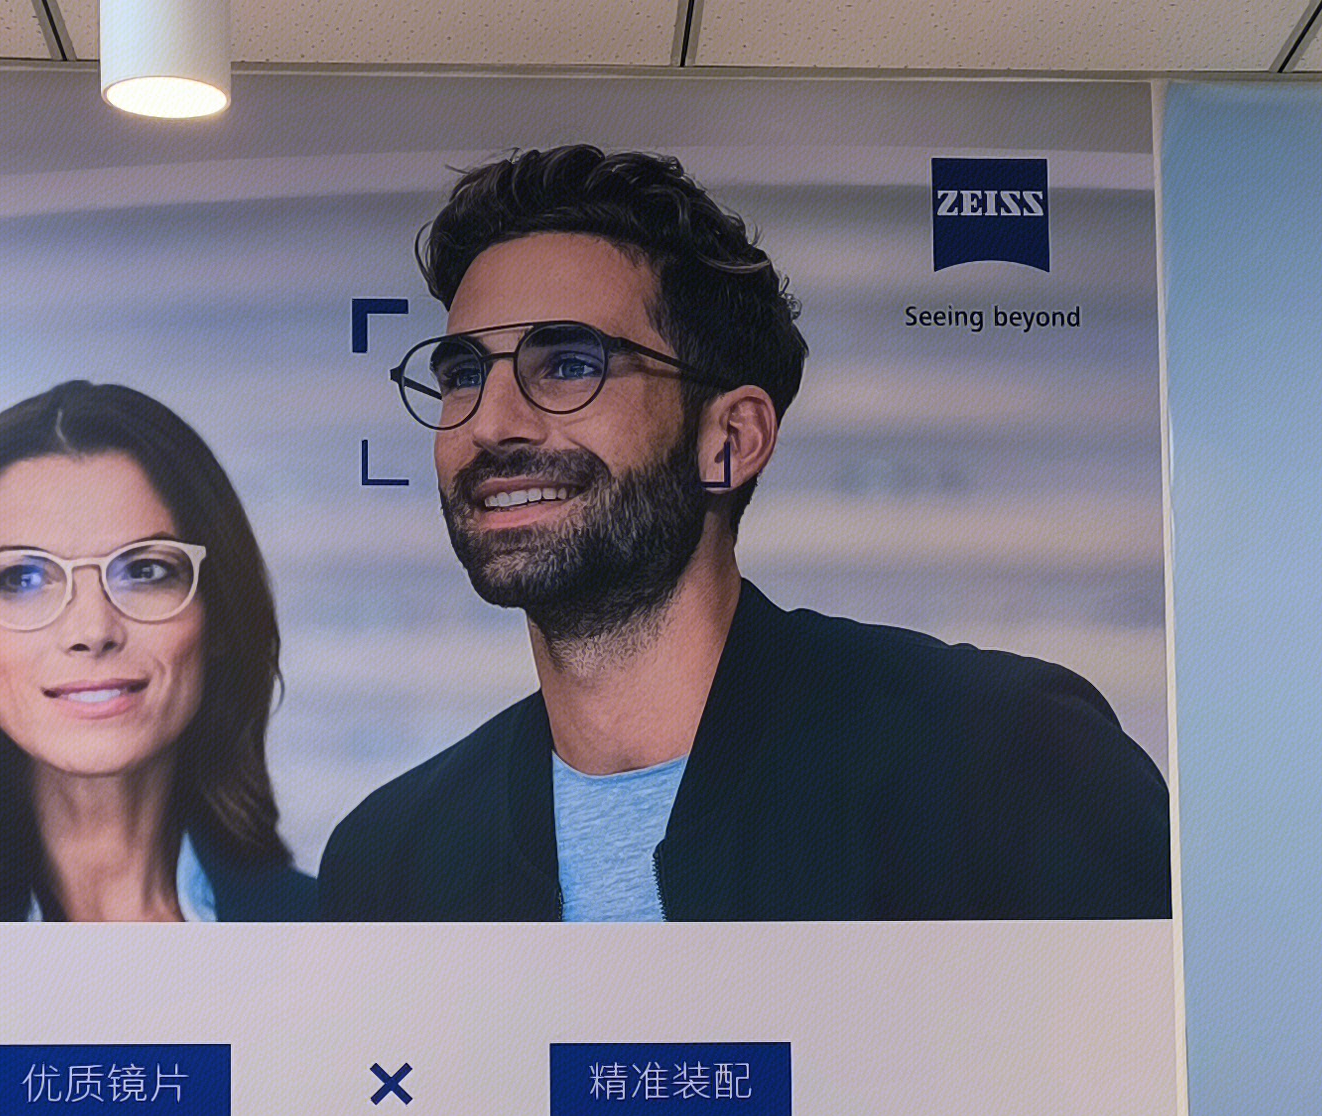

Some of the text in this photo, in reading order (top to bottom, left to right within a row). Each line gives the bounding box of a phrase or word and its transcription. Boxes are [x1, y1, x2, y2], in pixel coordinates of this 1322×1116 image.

[937, 190, 1044, 216] ZEISS
[905, 306, 1080, 333] Seeing beyond
[22, 1062, 188, 1103] 优质镜片
[589, 1061, 752, 1100] 精准装配
